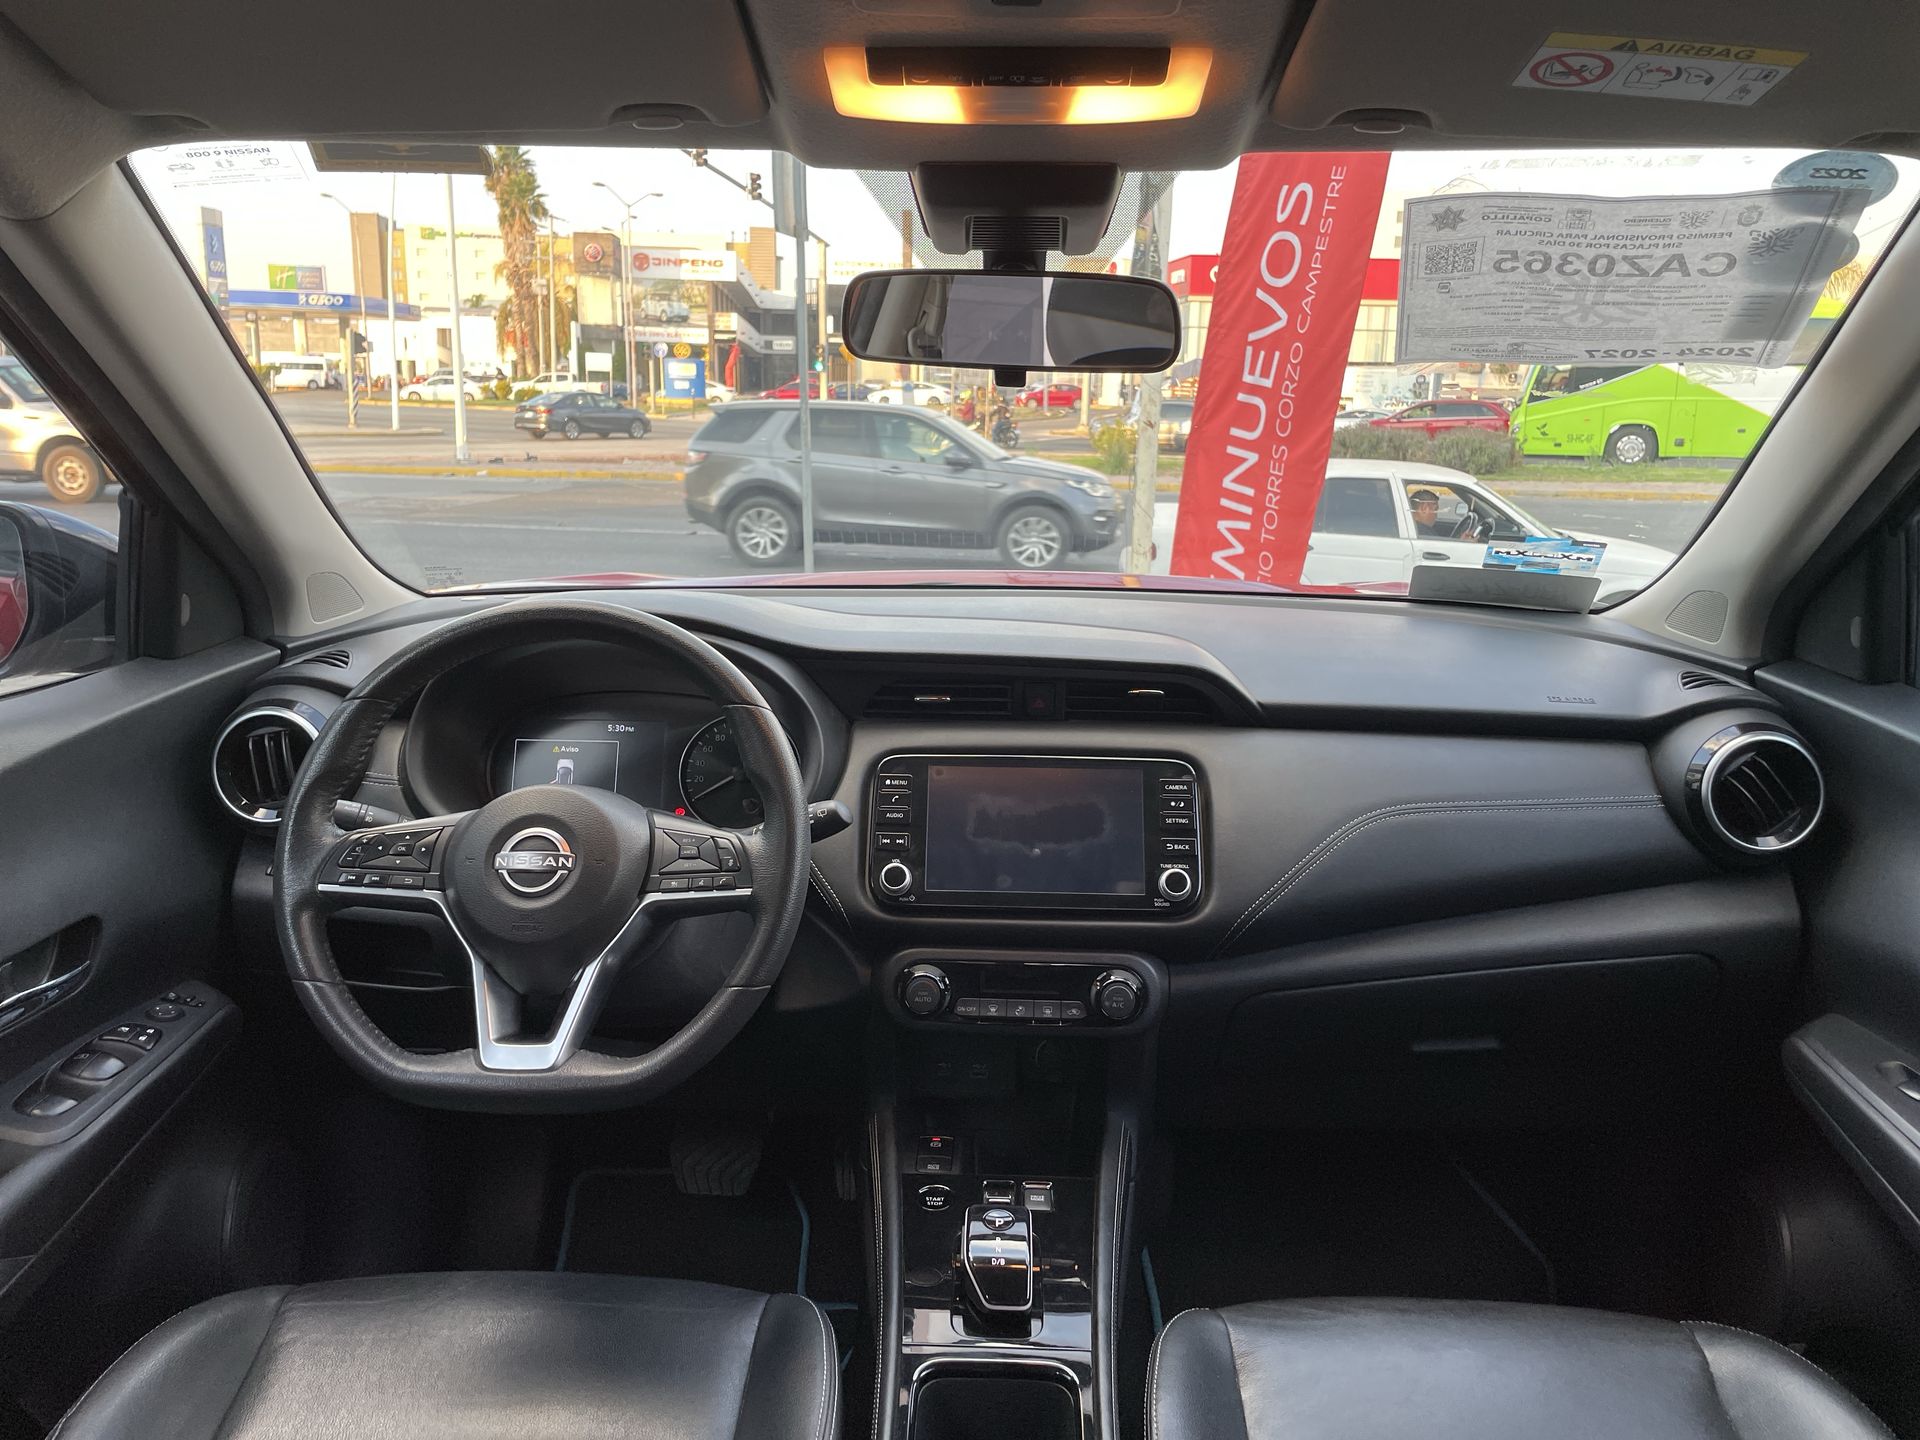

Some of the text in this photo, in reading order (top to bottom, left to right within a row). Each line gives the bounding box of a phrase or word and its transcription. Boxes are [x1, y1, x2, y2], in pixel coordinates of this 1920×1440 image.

[1645, 41, 1755, 60] AIRBAG
[224, 147, 271, 155] NISSAN
[651, 258, 724, 268] JINPENG
[1260, 446, 1289, 543] TORRES
[1275, 341, 1304, 438] CORZO
[1296, 164, 1348, 335] CAMPESTRE
[1210, 180, 1314, 582] MINUEVOS
[607, 724, 625, 732] 5:30
[715, 734, 726, 742] 80
[560, 745, 580, 753] Aviso
[702, 745, 713, 753] 60
[695, 759, 705, 767] 40
[694, 775, 704, 783] 20
[494, 855, 575, 869] NISSAN
[1111, 1001, 1125, 1009] A/C
[995, 1218, 1004, 1228] P
[991, 1257, 1006, 1266] D/B
